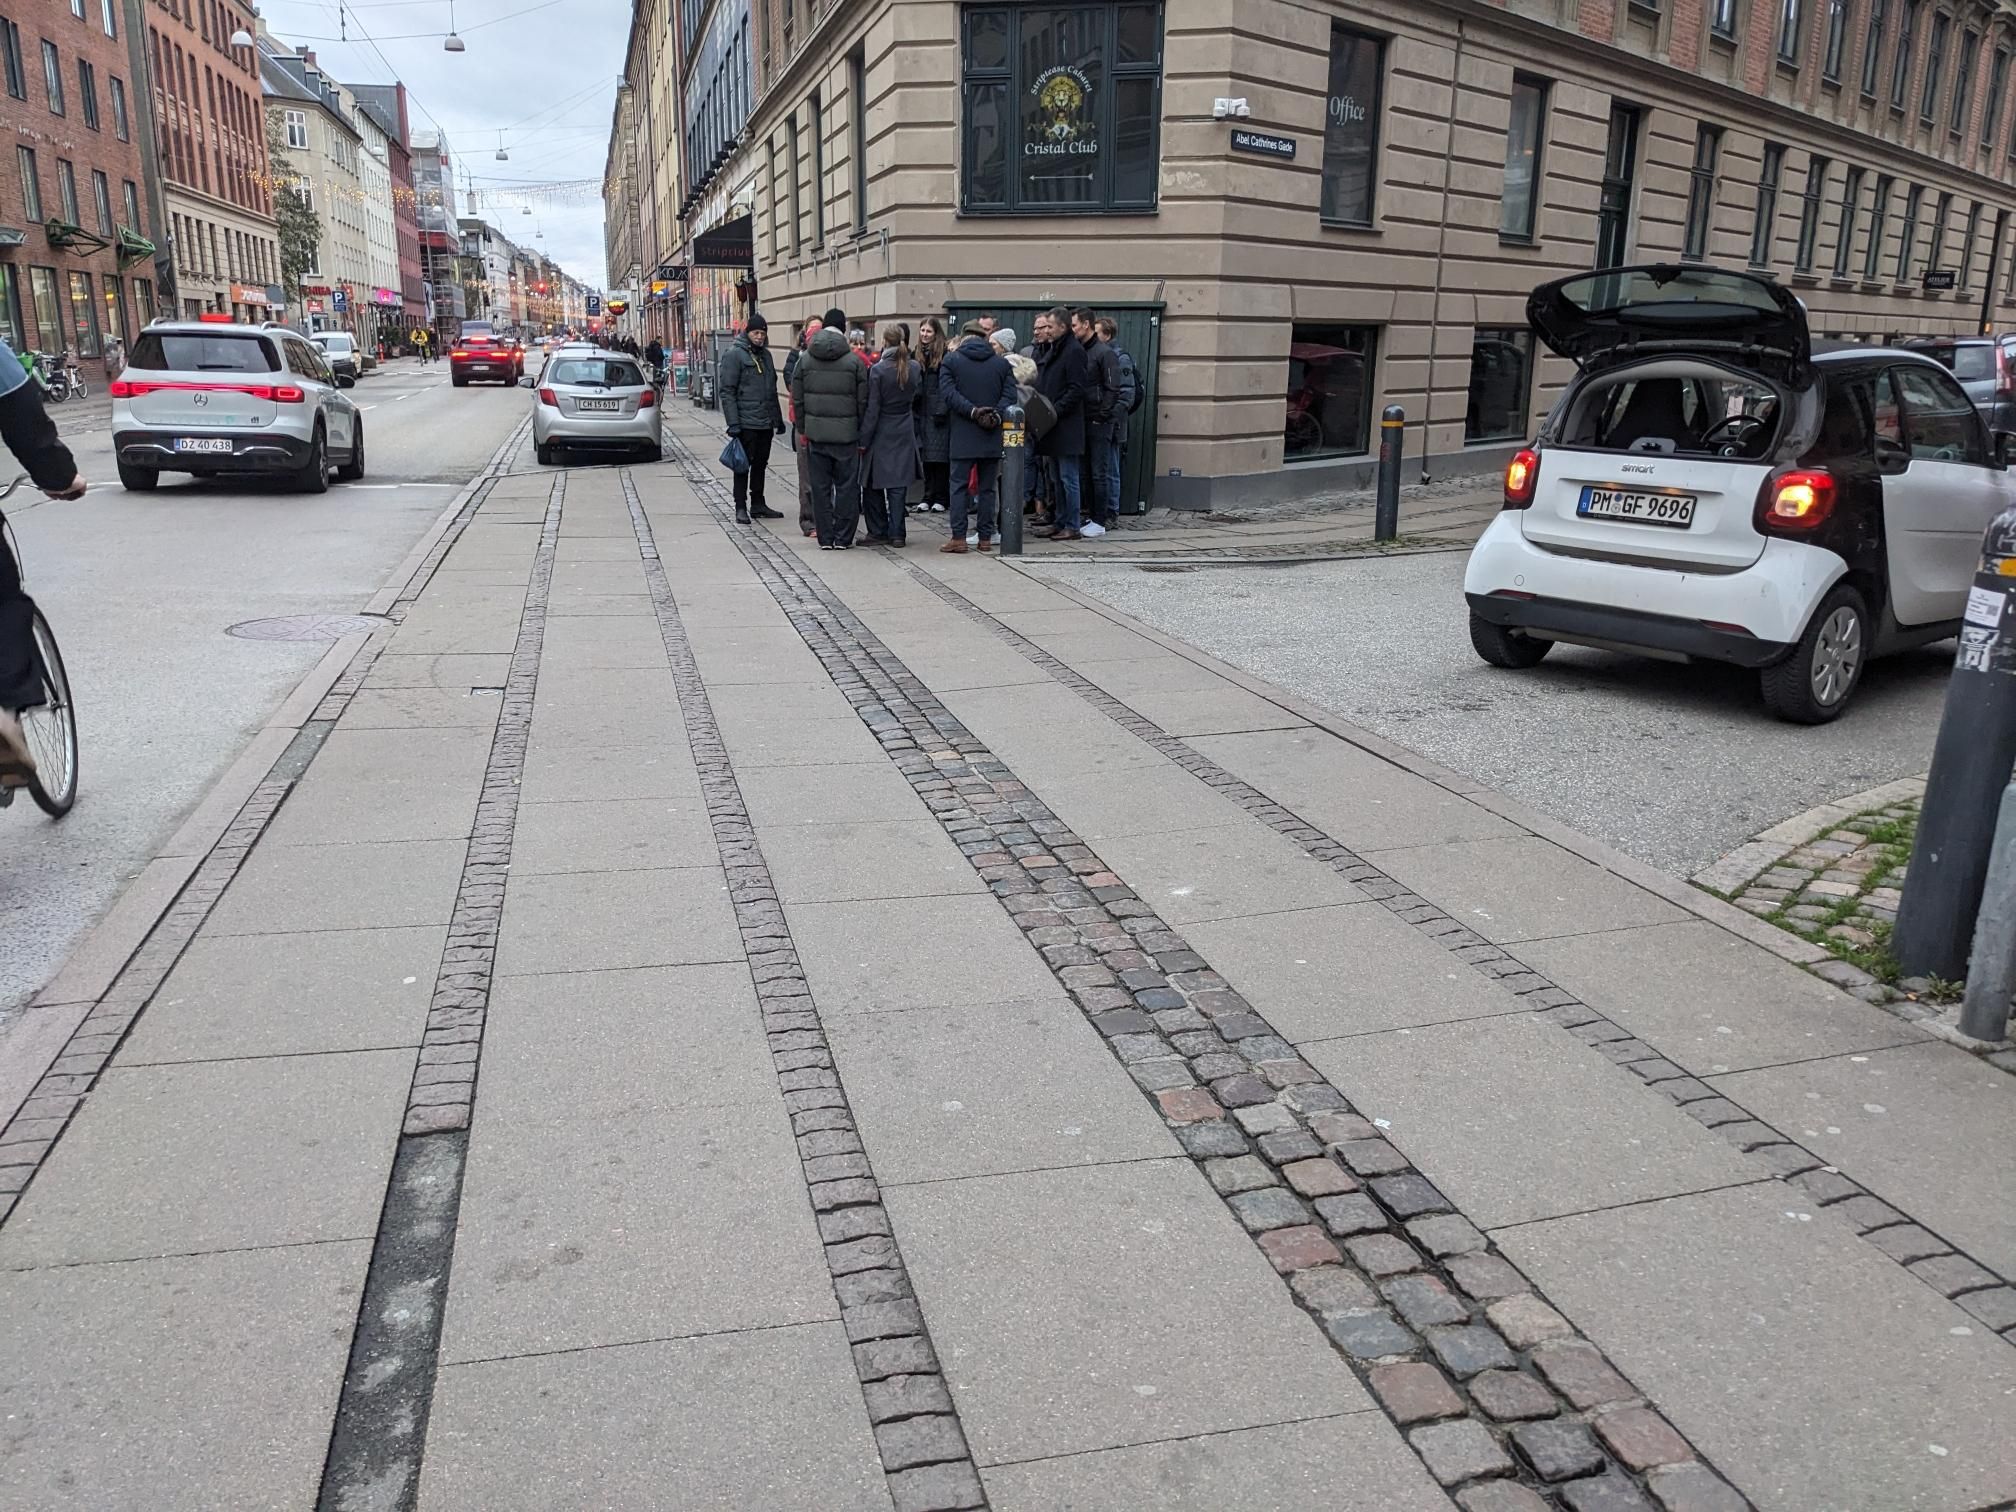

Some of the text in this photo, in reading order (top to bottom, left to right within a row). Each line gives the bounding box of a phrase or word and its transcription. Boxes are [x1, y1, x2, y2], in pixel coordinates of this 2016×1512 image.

[1031, 65, 1093, 95] Striptease Cabaret
[1330, 95, 1365, 126] Office
[1025, 139, 1098, 155] Cristal Club
[1236, 133, 1293, 153] Abel Cathrines Gade
[334, 292, 343, 303] P
[589, 297, 598, 308] P
[582, 400, 592, 408] CH
[181, 440, 231, 450] DZ 40 438
[1621, 463, 1655, 474] smart
[1590, 491, 1613, 511] PM
[1622, 495, 1646, 514] GF
[1647, 497, 1691, 519] 9696
